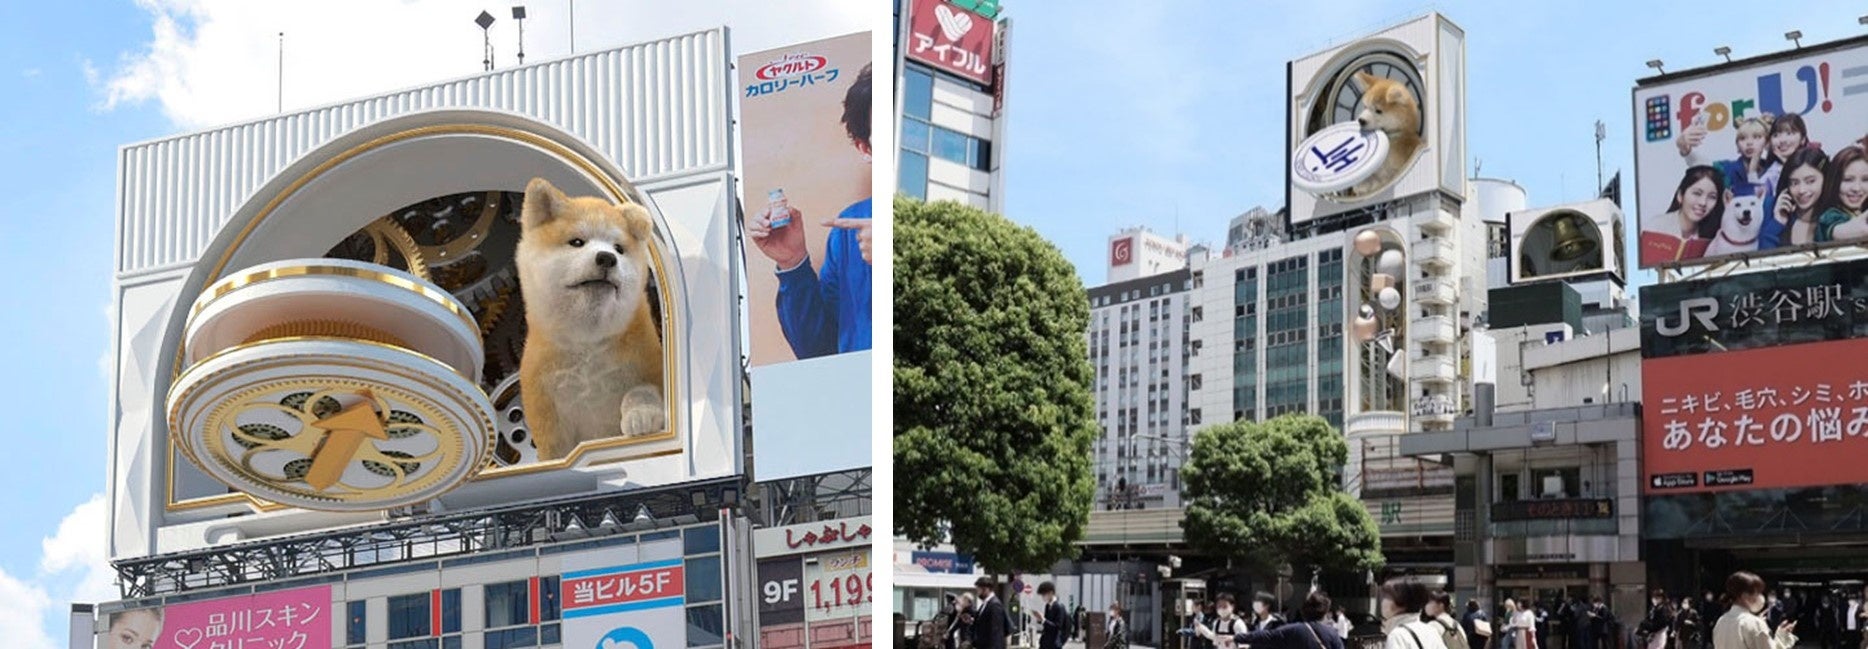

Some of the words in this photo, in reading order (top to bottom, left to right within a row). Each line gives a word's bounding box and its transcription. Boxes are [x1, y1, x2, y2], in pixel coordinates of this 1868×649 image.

[769, 60, 815, 76] ヤクルト
[914, 32, 987, 74] アイフル
[745, 69, 839, 97] カロリーハーフ
[1656, 297, 1720, 337] JR
[1729, 283, 1845, 328] 渋谷駅
[1663, 406, 1868, 450] あなたの悩み
[785, 522, 872, 549] しゃぶしゃ
[574, 571, 671, 604] 当ビル5F
[763, 578, 798, 604] 9F
[205, 602, 321, 638] 品川スキン
